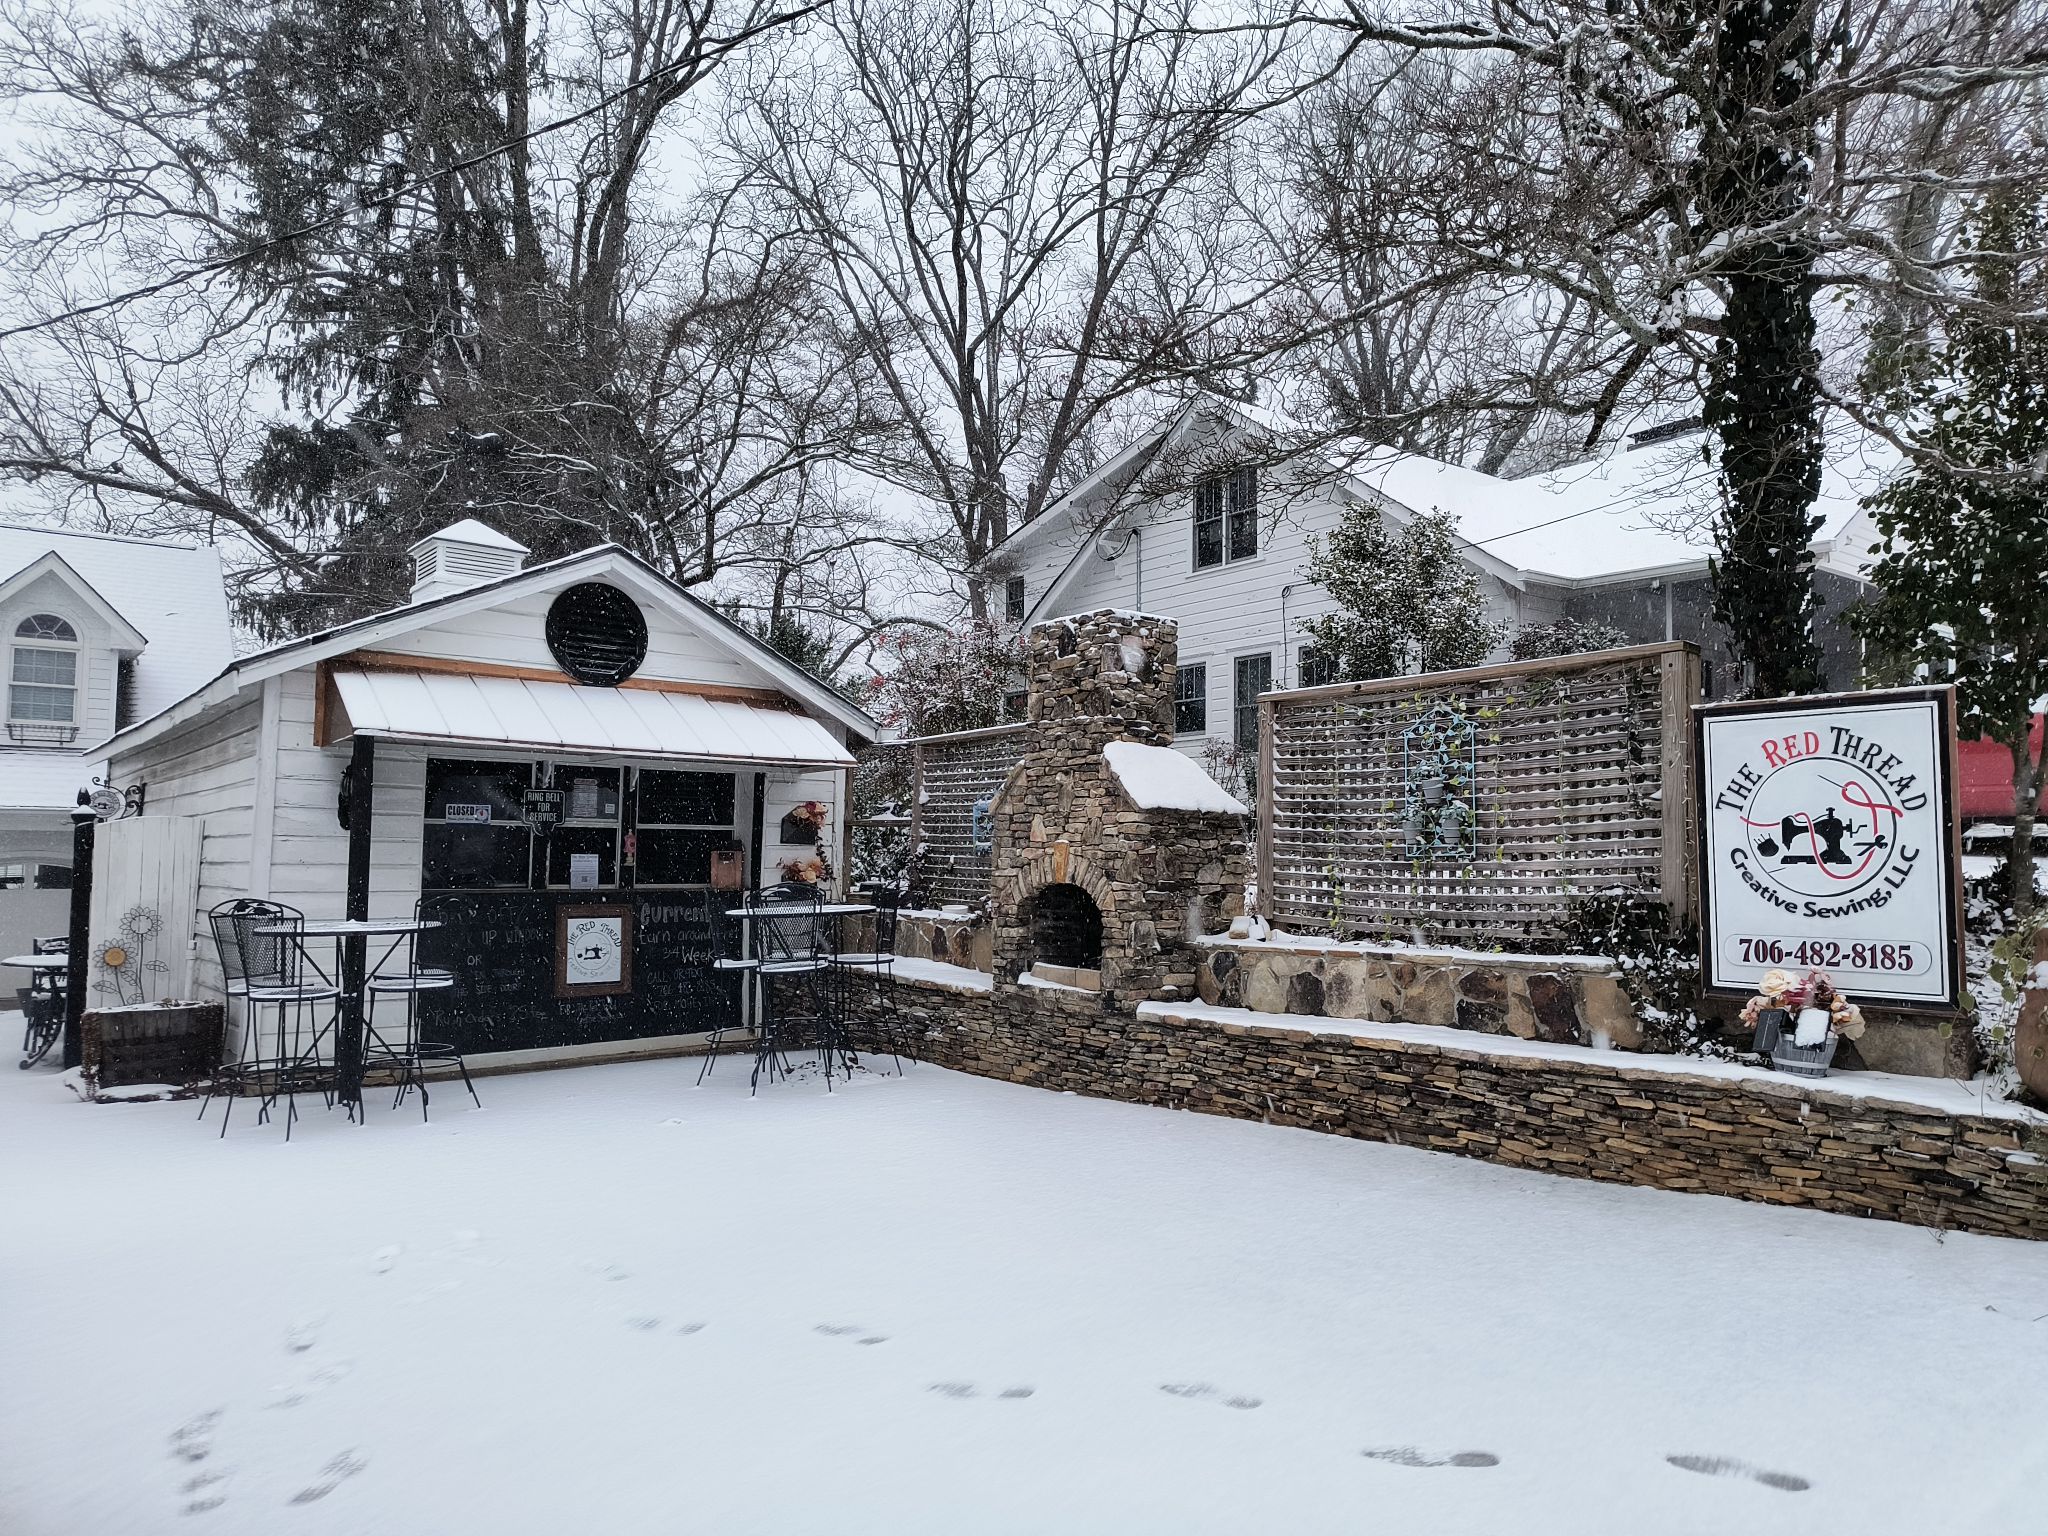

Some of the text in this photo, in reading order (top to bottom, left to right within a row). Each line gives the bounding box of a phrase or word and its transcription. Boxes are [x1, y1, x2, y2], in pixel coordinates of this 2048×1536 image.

[1715, 726, 1928, 812] THE RED THREAD
[527, 793, 560, 802] RING BELL
[447, 805, 475, 816] CLOSED
[537, 802, 551, 811] FOR
[530, 812, 558, 822] SERVICE
[1730, 844, 1920, 919] Creative Sewing, LLC
[567, 920, 622, 948] THE RED THREAD
[466, 954, 483, 966] OR
[1738, 938, 1914, 971] 706-482-8185
